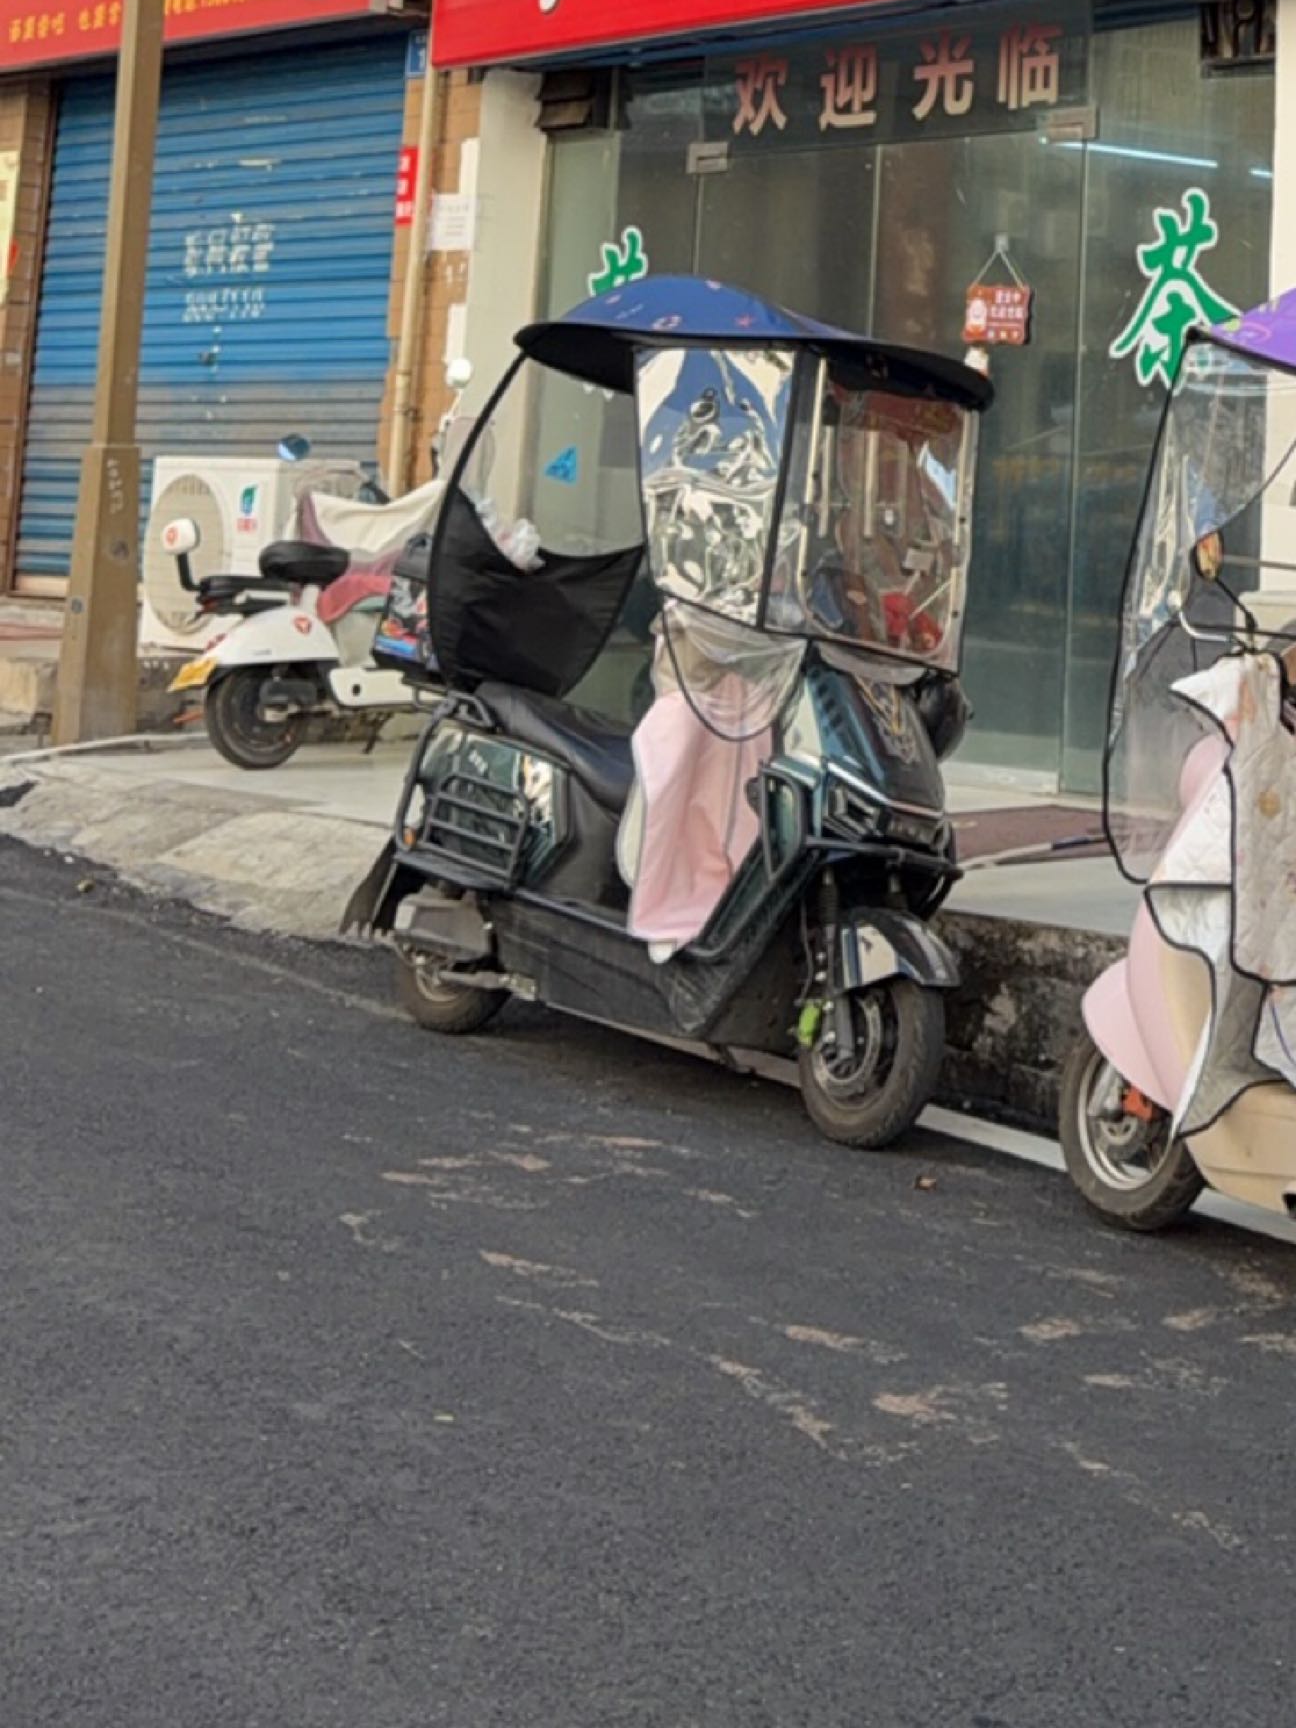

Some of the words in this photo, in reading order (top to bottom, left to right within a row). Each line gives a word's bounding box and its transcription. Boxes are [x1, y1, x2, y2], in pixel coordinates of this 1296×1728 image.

[732, 23, 1065, 137] 欢迎光临
[1110, 188, 1242, 388] 茶
